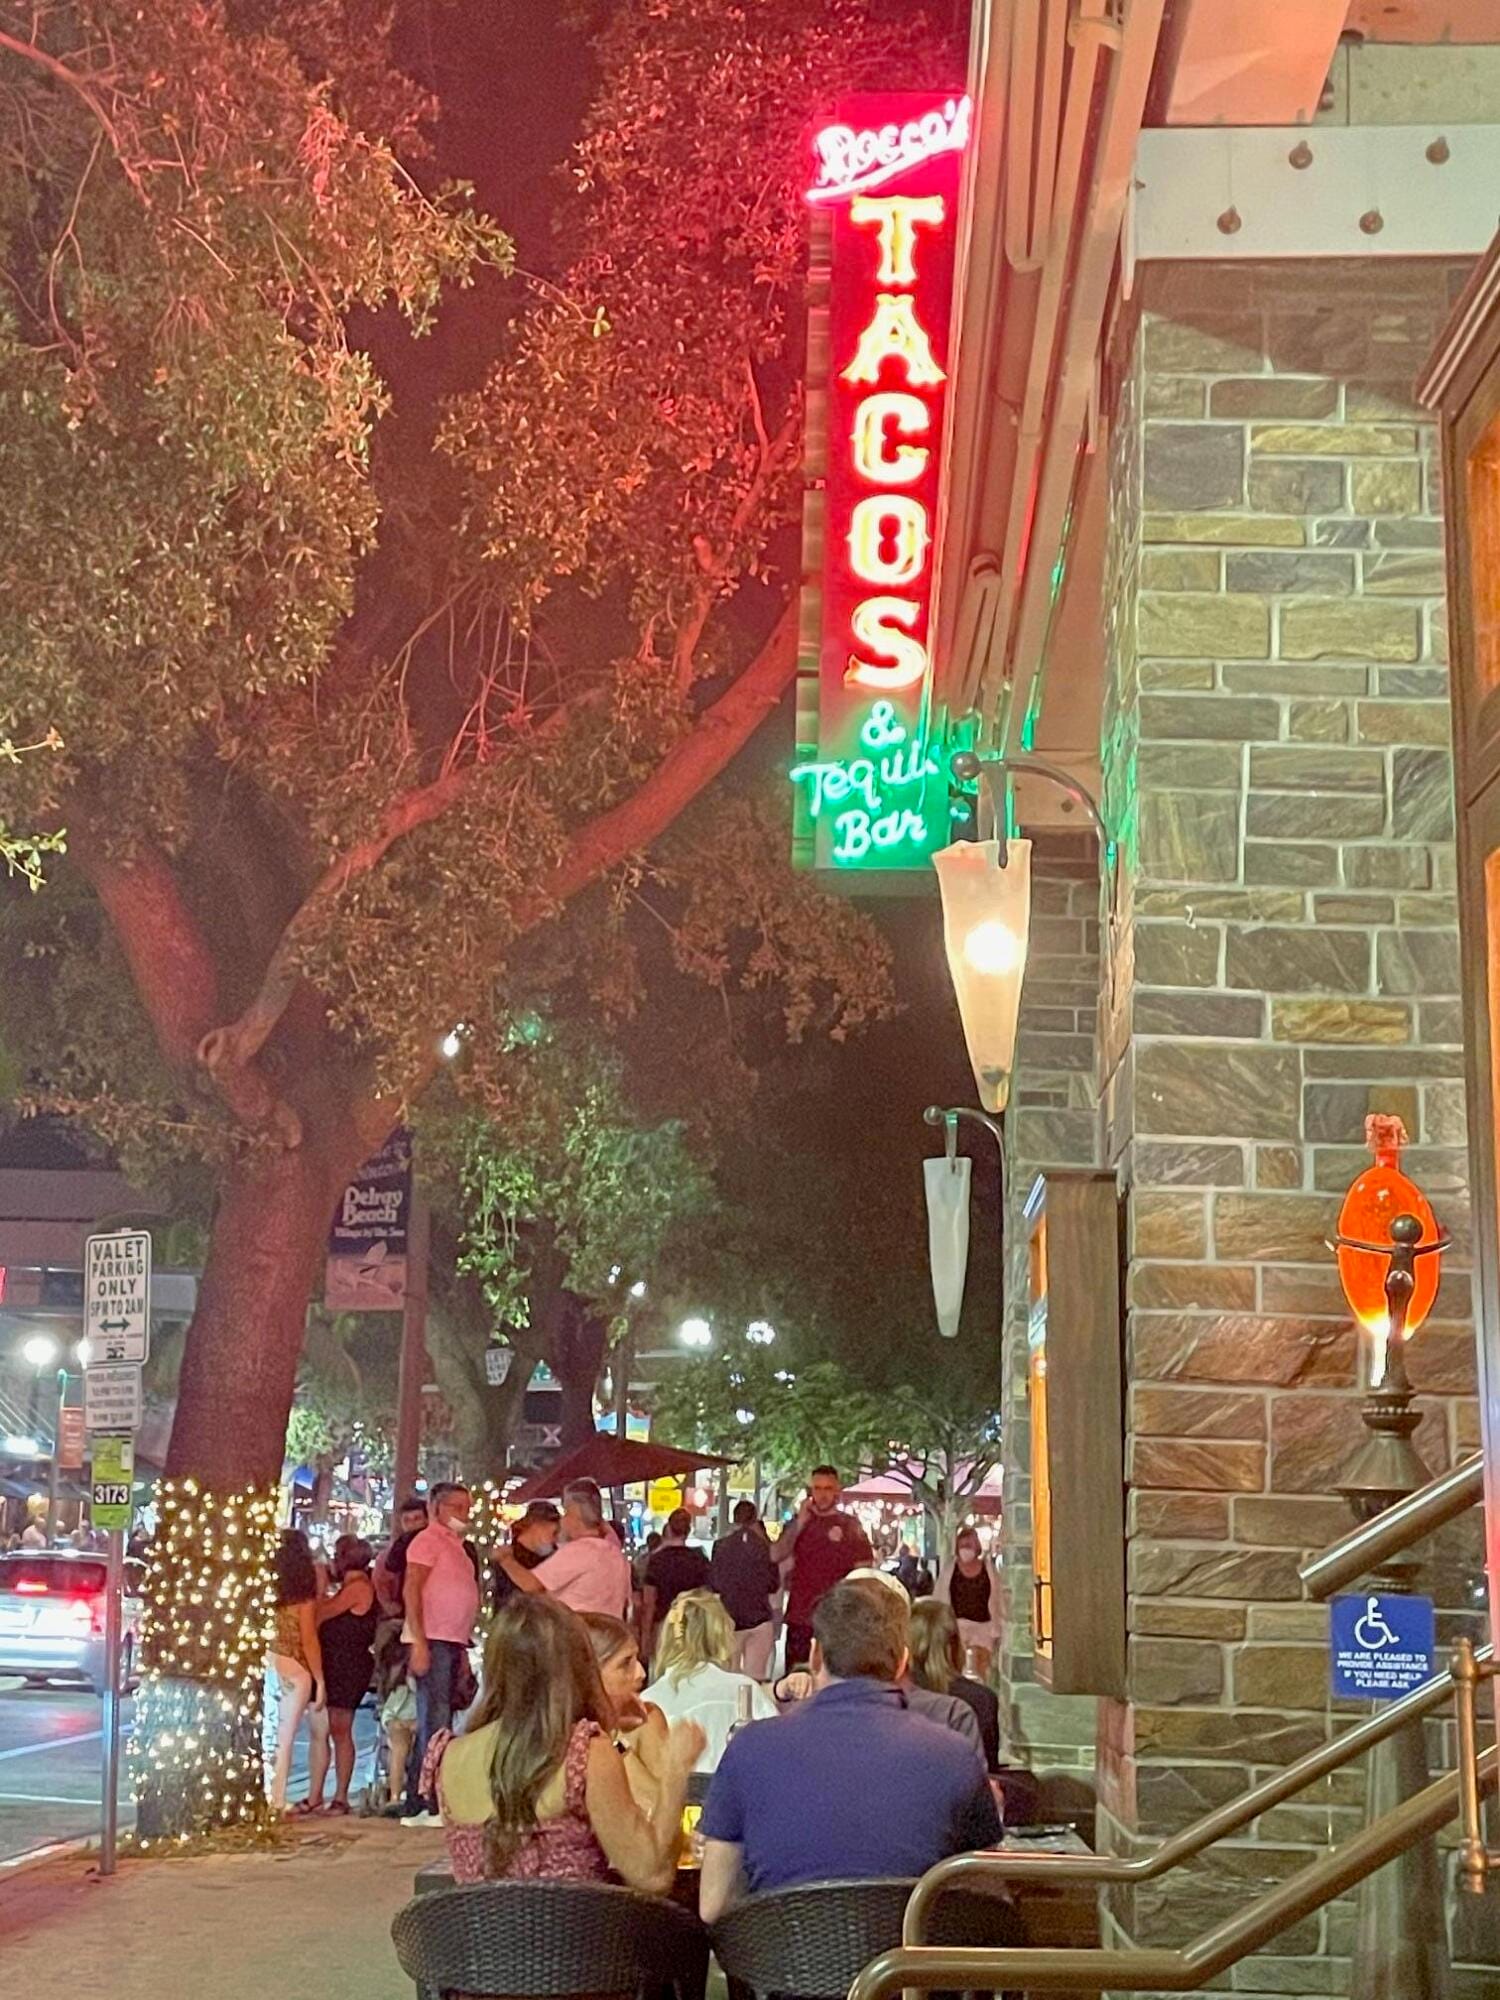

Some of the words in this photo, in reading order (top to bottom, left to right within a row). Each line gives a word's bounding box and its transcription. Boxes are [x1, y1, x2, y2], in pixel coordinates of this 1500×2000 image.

[838, 194, 948, 688] TACOS
[861, 700, 906, 747] &
[833, 809, 928, 858] Bar
[345, 1186, 403, 1208] Delray
[342, 1203, 397, 1226] Beach
[93, 1240, 143, 1260] VALET
[91, 1260, 144, 1279] PARKING
[97, 1278, 136, 1297] ONLY
[110, 1300, 124, 1316] TO
[95, 1485, 128, 1504] 3173
[1337, 1660, 1374, 1669] PROVIDE
[1375, 1661, 1429, 1671] ASSISTANCE
[1338, 1651, 1352, 1660] WE
[1353, 1652, 1371, 1660] ARE
[1373, 1652, 1413, 1662] PLEASED
[1414, 1653, 1427, 1662] TO
[1353, 1670, 1372, 1679] YOU
[1373, 1671, 1398, 1680] NEED
[1399, 1672, 1422, 1681] HELP
[1355, 1679, 1390, 1688] PLEASE
